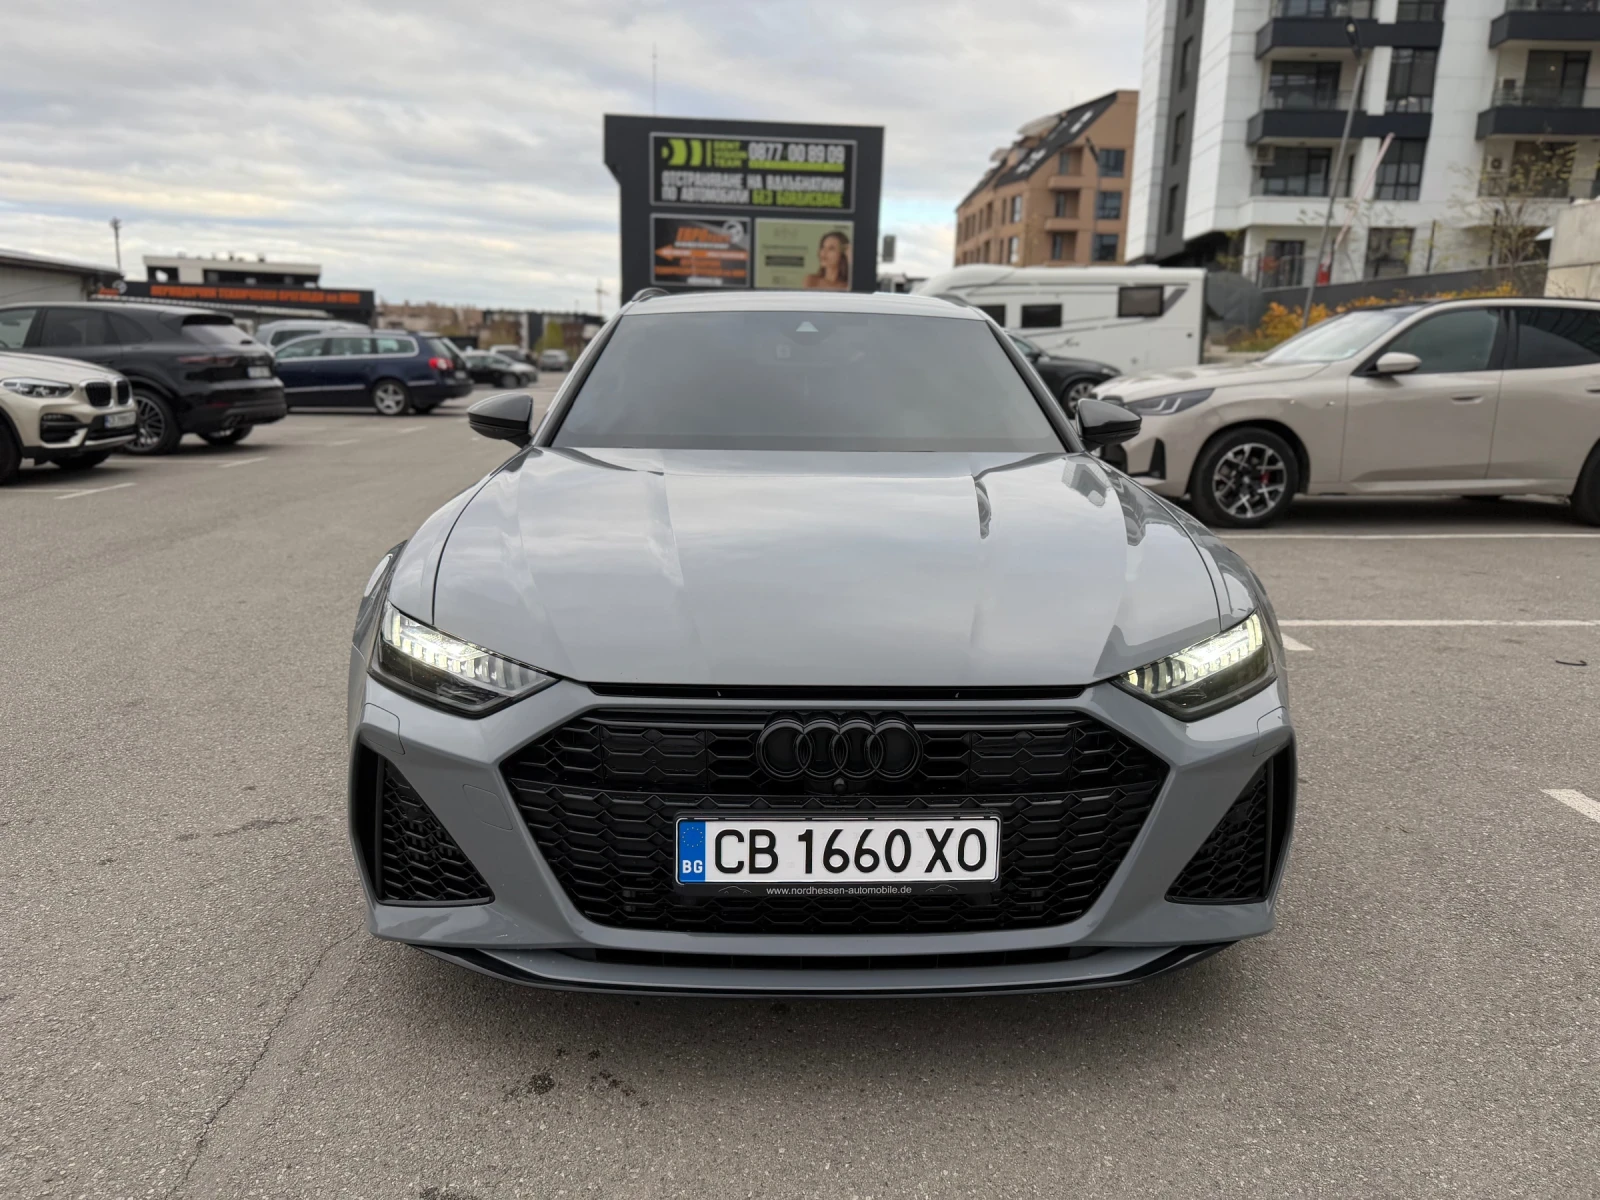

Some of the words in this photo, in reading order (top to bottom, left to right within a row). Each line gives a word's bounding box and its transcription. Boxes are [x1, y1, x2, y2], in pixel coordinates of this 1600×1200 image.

[748, 141, 784, 161] 0877
[787, 143, 806, 163] 00
[807, 144, 826, 163] 89
[826, 145, 846, 164] 09
[746, 173, 764, 190] НА
[661, 186, 678, 201] ПО
[751, 189, 774, 205] БЕЗ
[714, 828, 779, 874] CB
[797, 828, 912, 874] 1660
[923, 827, 988, 873] XO
[682, 859, 704, 874] BG
[765, 884, 913, 897] www.nordhessen-automobile.de
